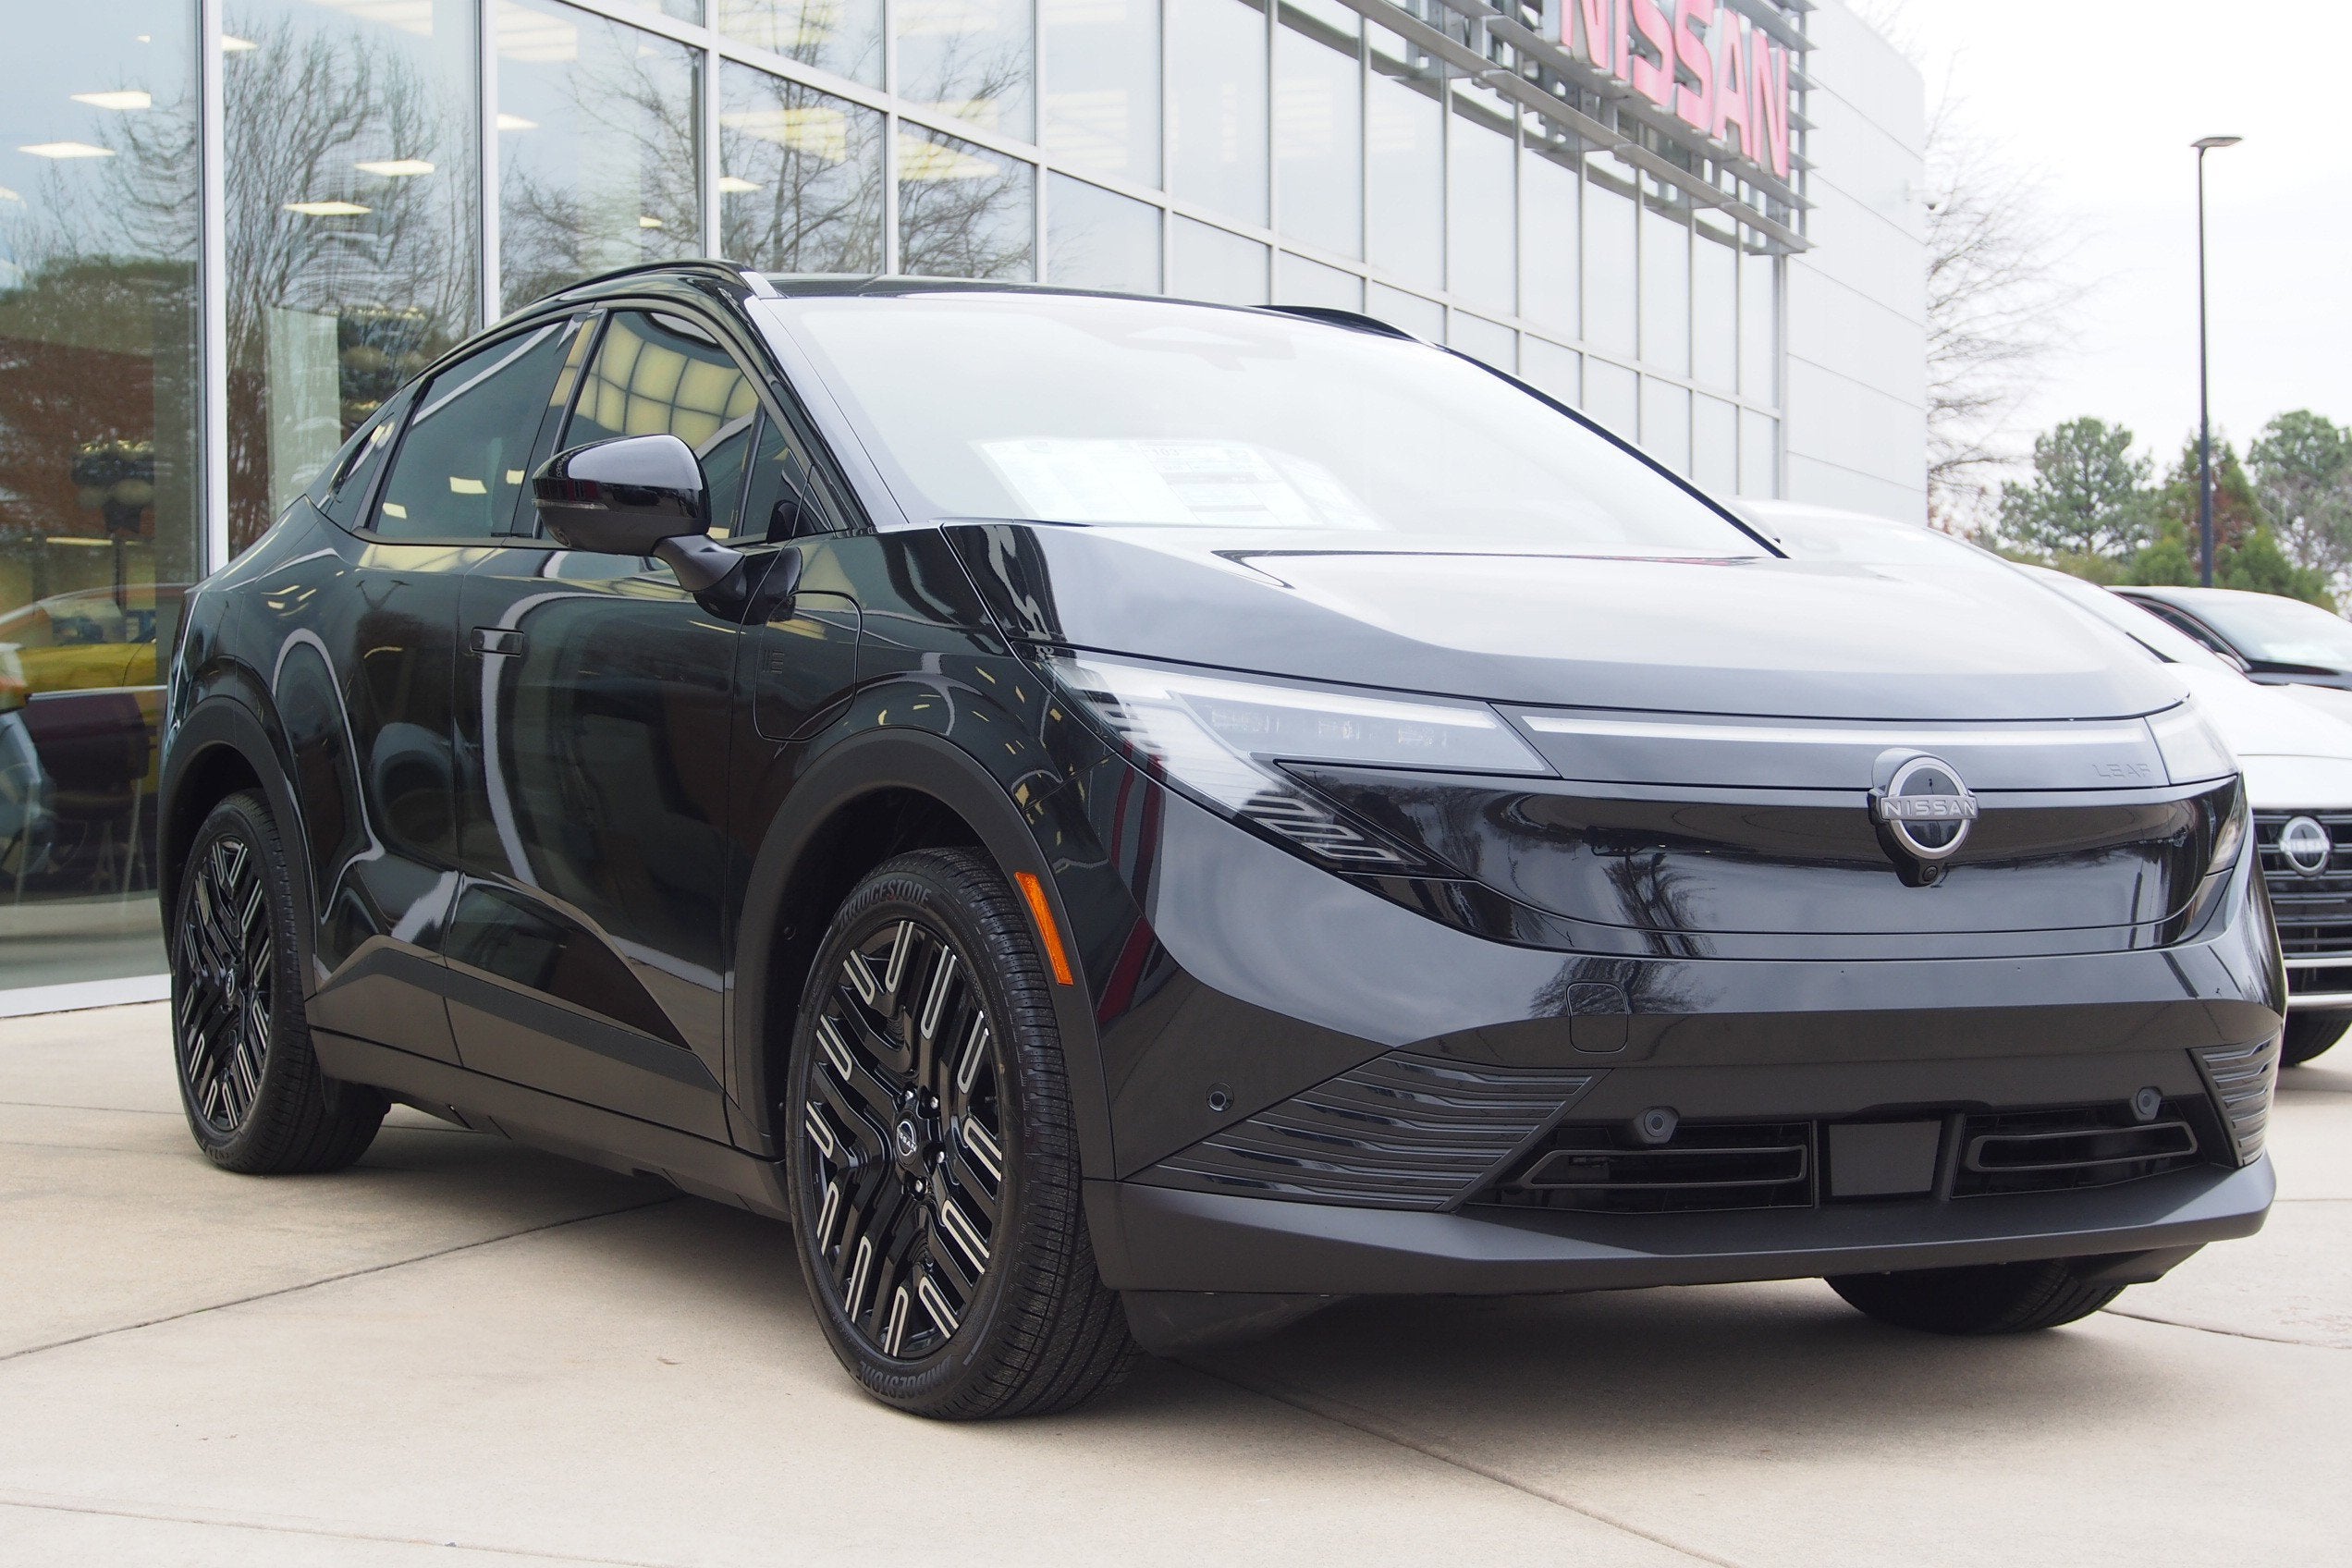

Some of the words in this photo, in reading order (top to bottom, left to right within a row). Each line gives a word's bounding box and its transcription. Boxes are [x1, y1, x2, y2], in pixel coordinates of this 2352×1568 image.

[2091, 763, 2151, 778] LEAF
[1885, 800, 1977, 816] NISSAN
[839, 878, 932, 930] BRIDGESTONE
